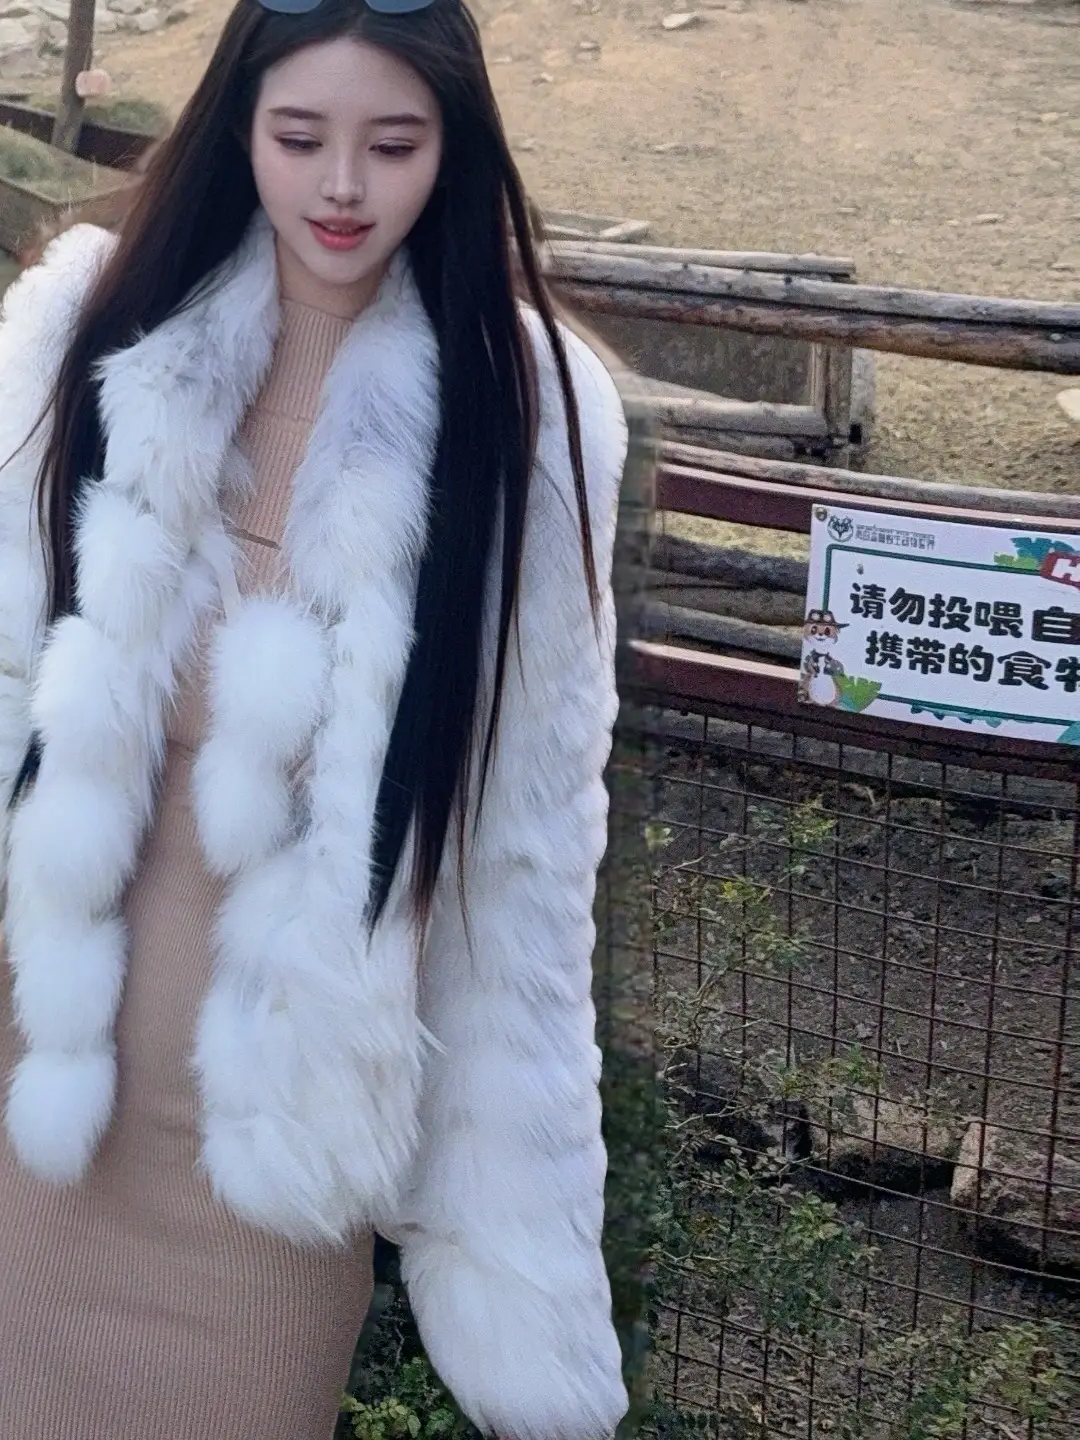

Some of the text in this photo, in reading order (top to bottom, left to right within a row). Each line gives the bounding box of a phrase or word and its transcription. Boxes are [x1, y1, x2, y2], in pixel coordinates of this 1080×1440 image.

[850, 582, 1080, 645] 请勿投喂自
